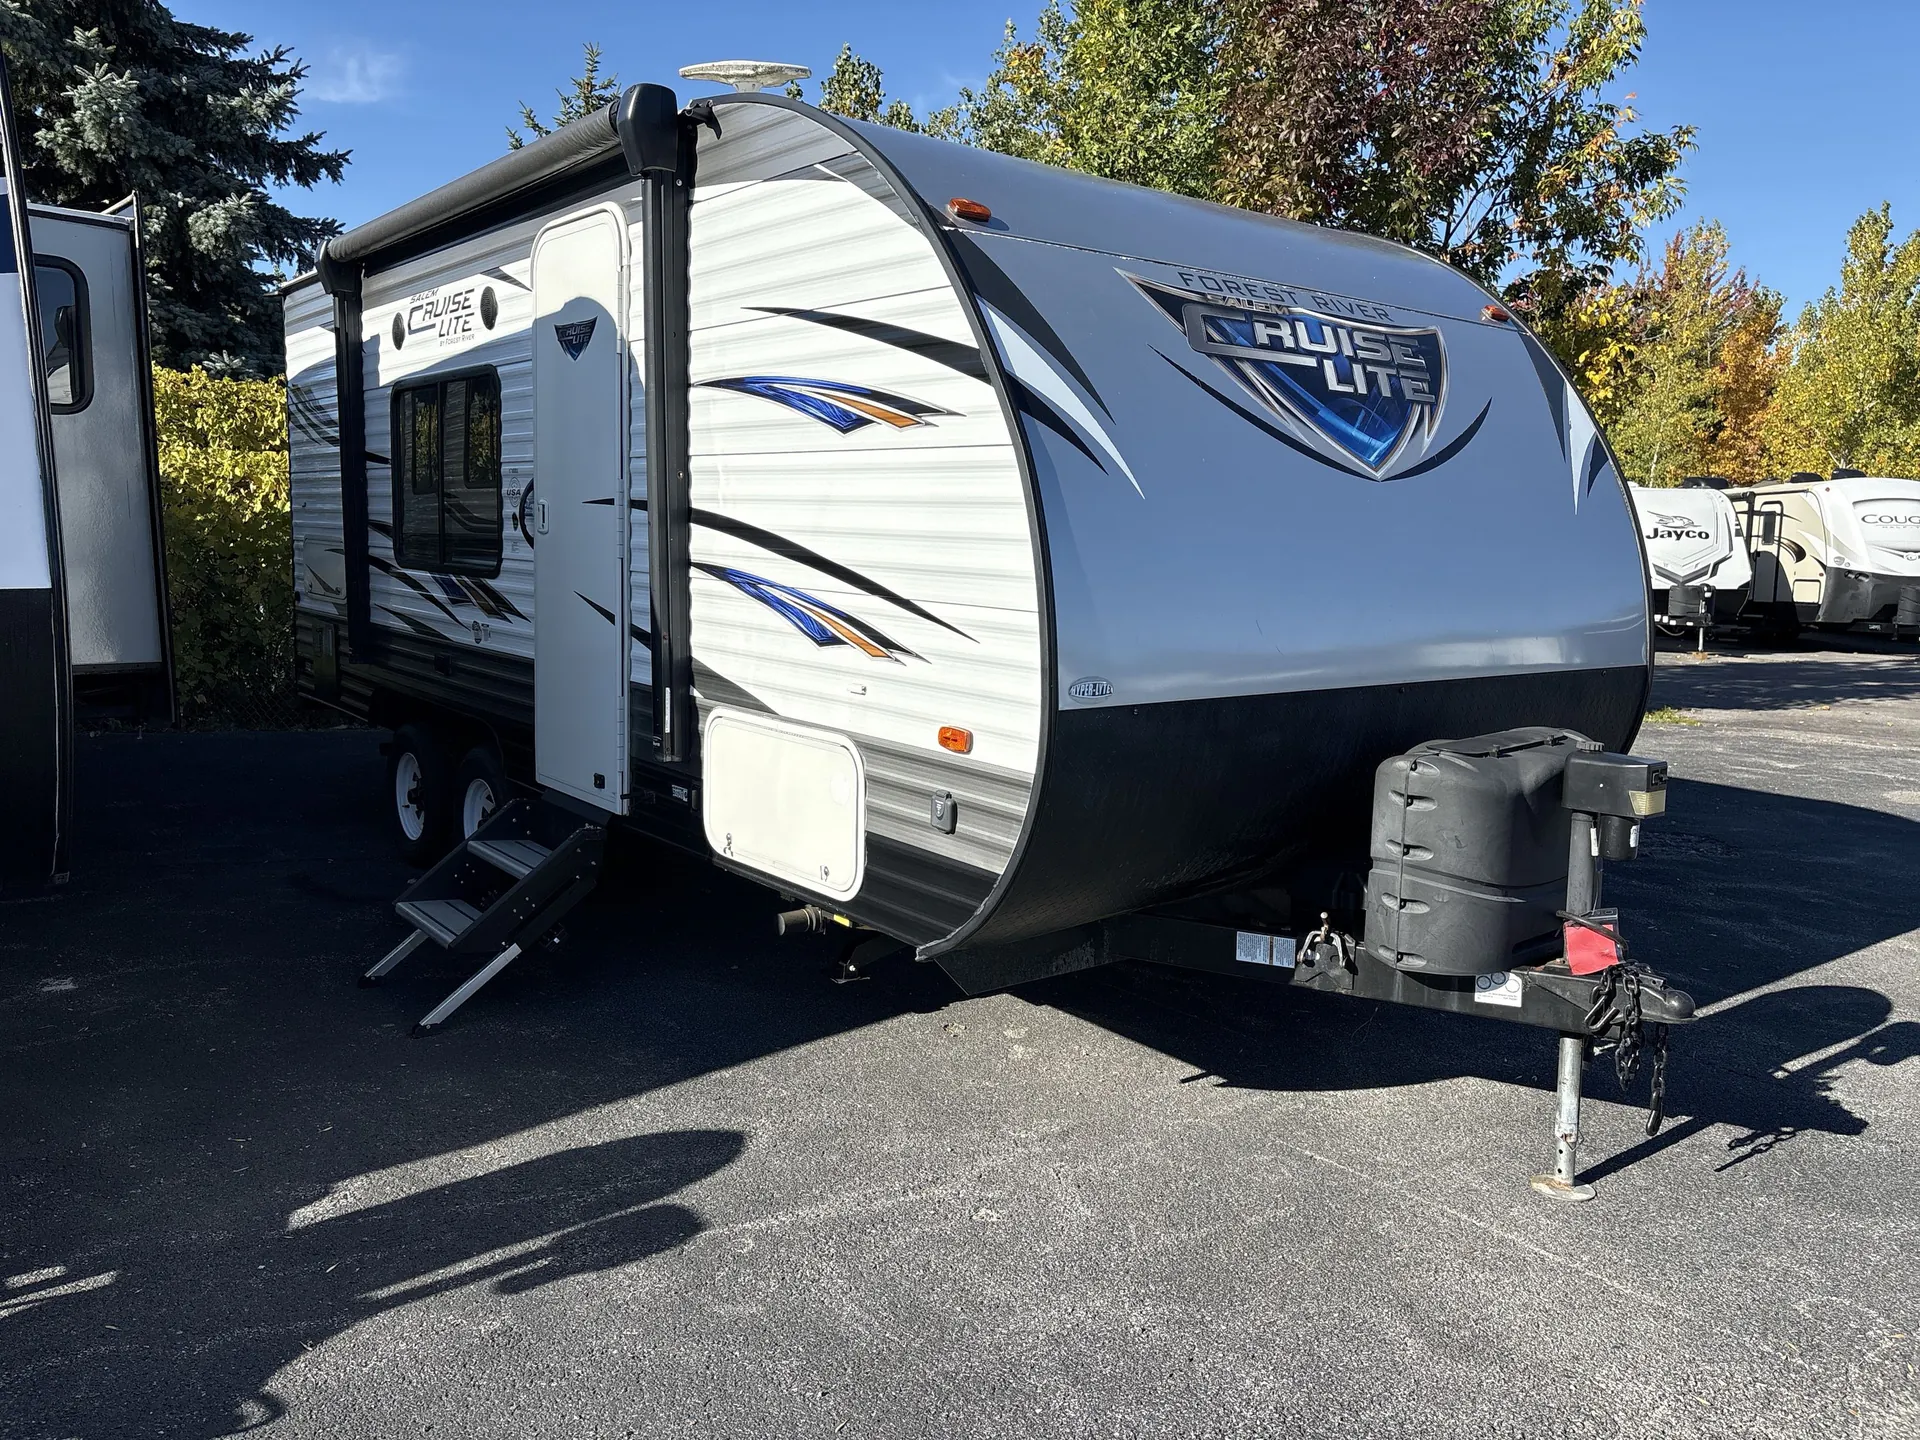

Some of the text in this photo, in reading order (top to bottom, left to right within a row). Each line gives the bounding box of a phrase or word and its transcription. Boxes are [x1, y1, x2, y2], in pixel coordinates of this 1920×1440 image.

[407, 288, 475, 336] CRUISE
[409, 288, 440, 304] SALEM
[1177, 271, 1395, 323] FOREST RIVER
[1206, 293, 1290, 316] SALEM
[438, 312, 475, 338] LITE
[1182, 303, 1427, 368] CRUISE
[1323, 358, 1436, 405] LITE
[1645, 528, 1710, 541] Jayco
